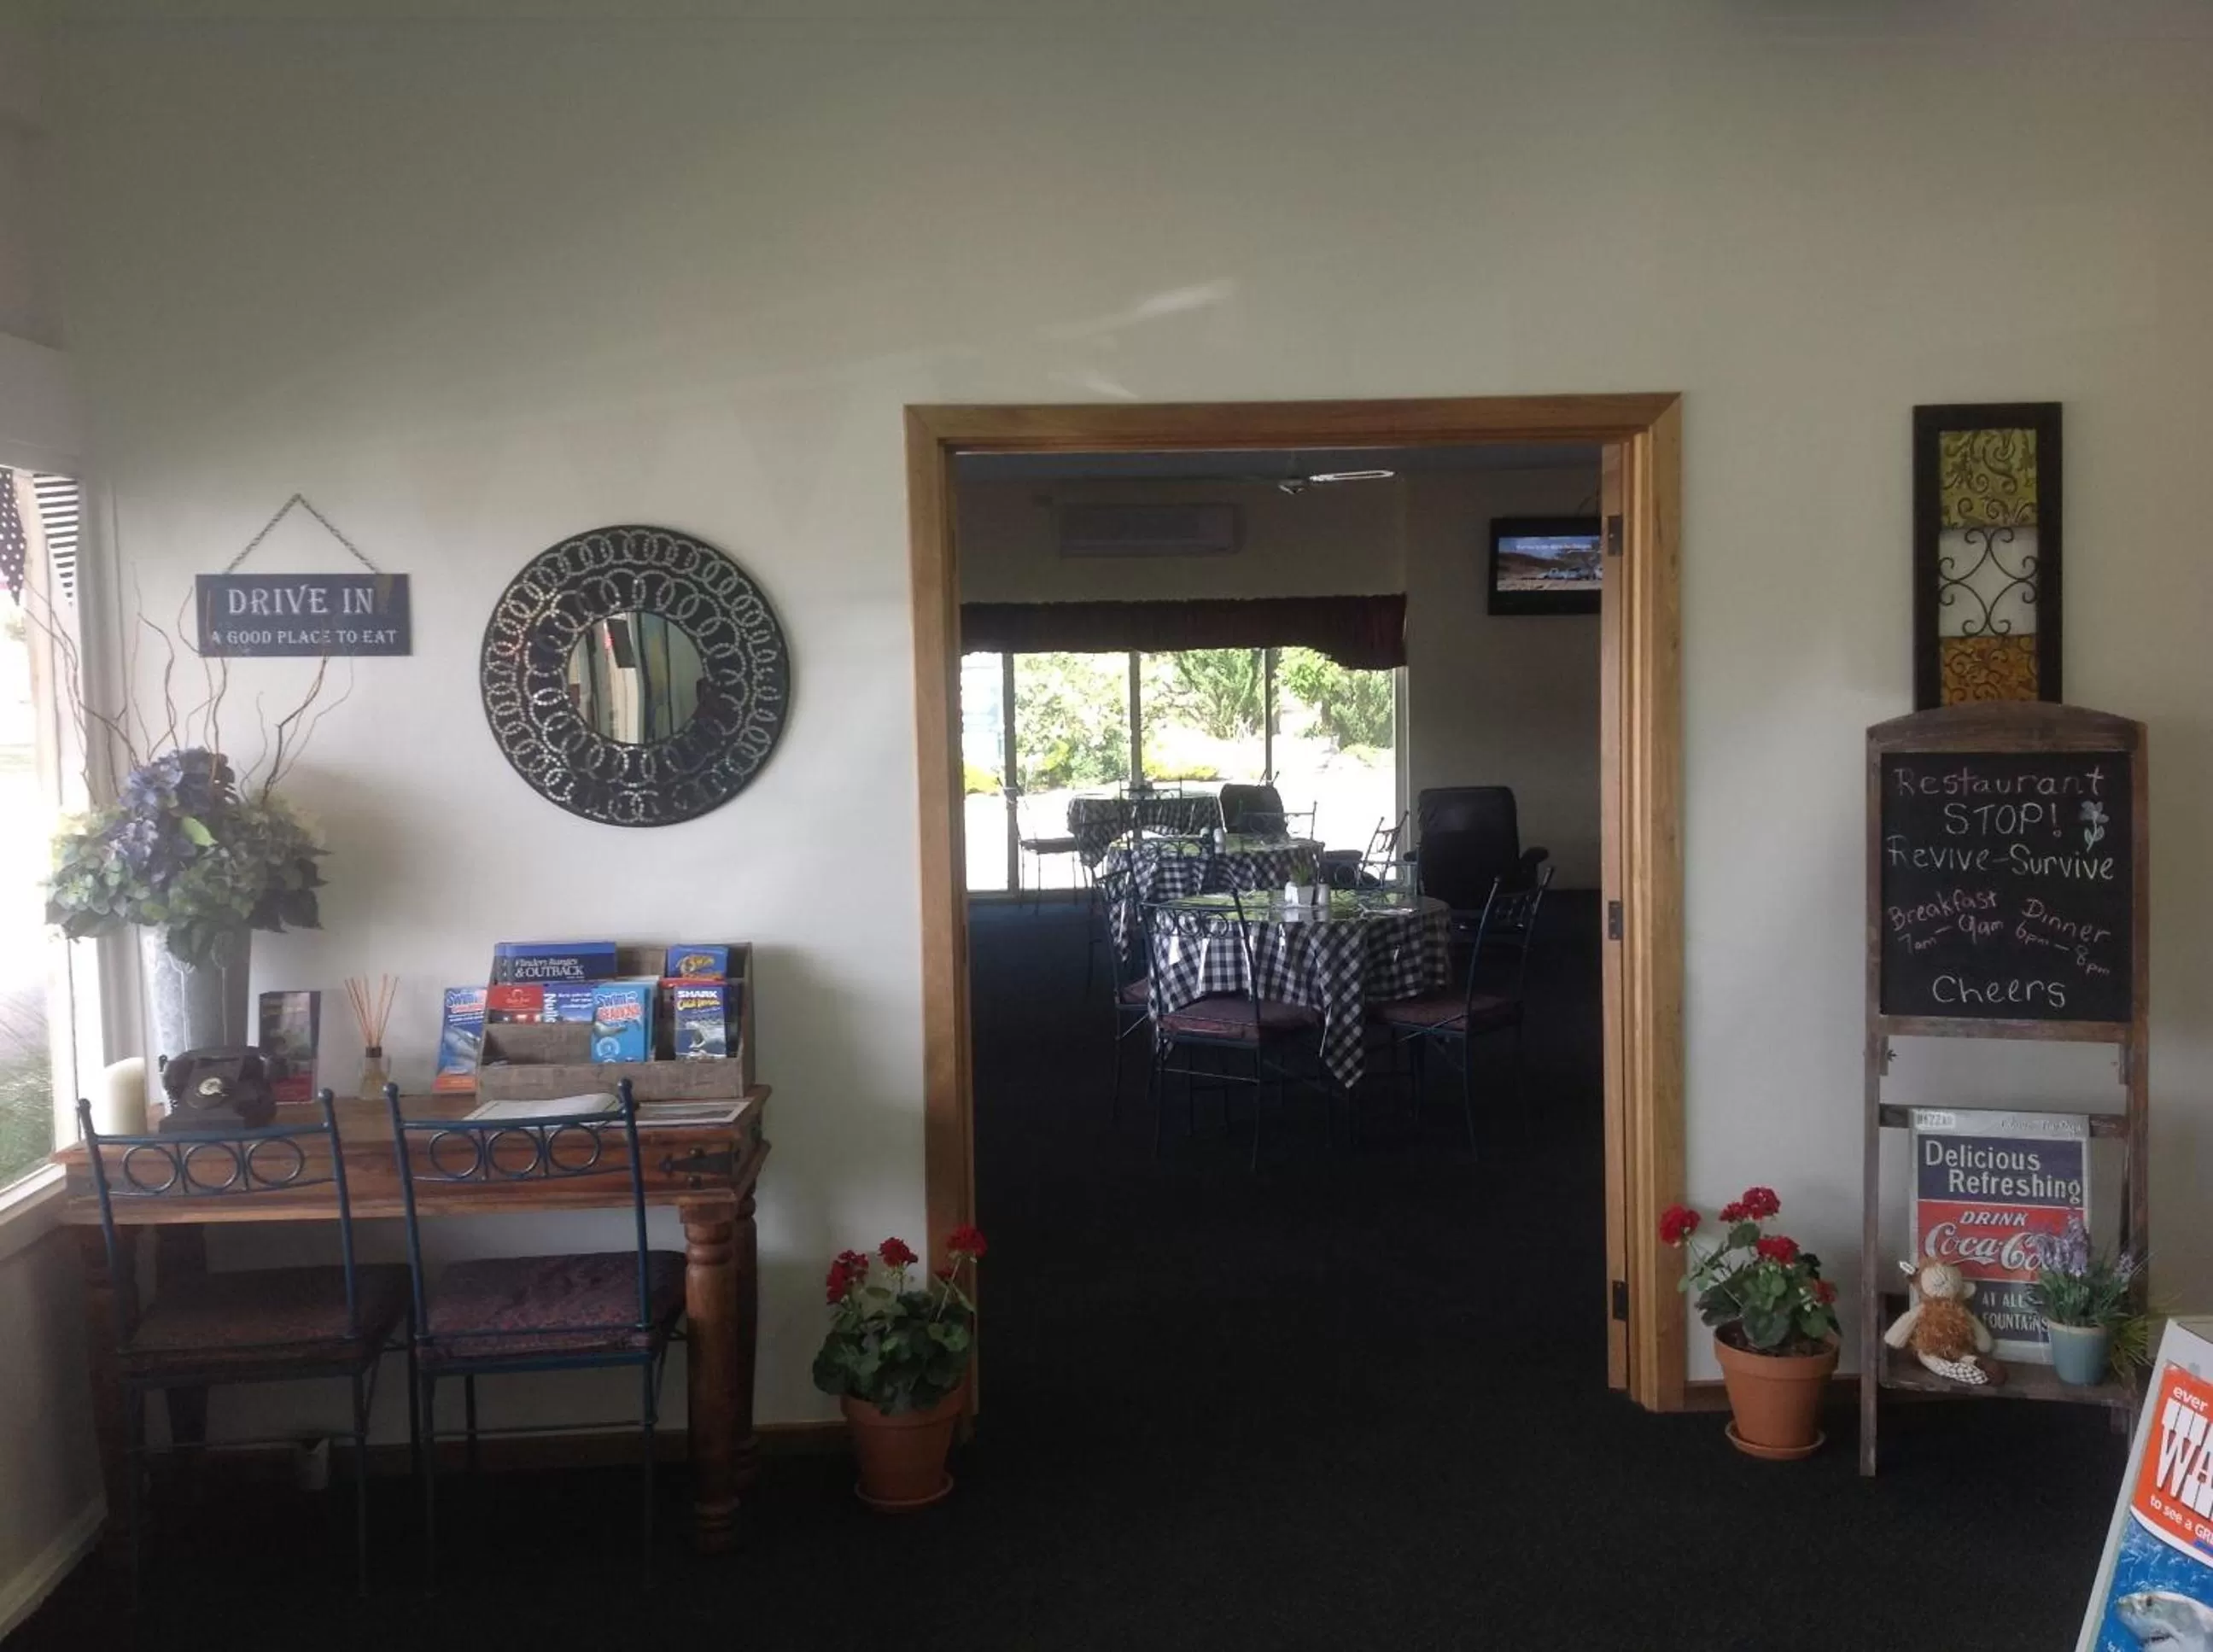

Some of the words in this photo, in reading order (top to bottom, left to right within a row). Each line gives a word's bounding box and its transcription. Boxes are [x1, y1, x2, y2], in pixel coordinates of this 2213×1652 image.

[227, 584, 329, 616] DRIVE
[342, 587, 374, 615] IN
[211, 630, 220, 645] A
[226, 630, 272, 645] GOOD
[277, 630, 331, 645] PLACE
[336, 630, 358, 645] TO
[362, 630, 400, 645] EAT
[1894, 765, 2105, 797] Restaurant
[1943, 803, 2063, 838] STOP!
[1888, 889, 1999, 931] Breakfast
[2021, 897, 2111, 943] Dinner
[1932, 974, 2067, 1008] Cheers
[1924, 1140, 2041, 1171] Delicious
[1948, 1169, 2082, 1205] Refreshing
[1960, 1211, 2029, 1227] DRINK
[1982, 1291, 1996, 1307] AT
[2001, 1291, 2028, 1309] ALL
[2172, 1385, 2210, 1414] ever
[2156, 1397, 2213, 1521] WA
[2150, 1494, 2163, 1511] to
[2163, 1504, 2183, 1525] see
[2184, 1519, 2193, 1532] a
